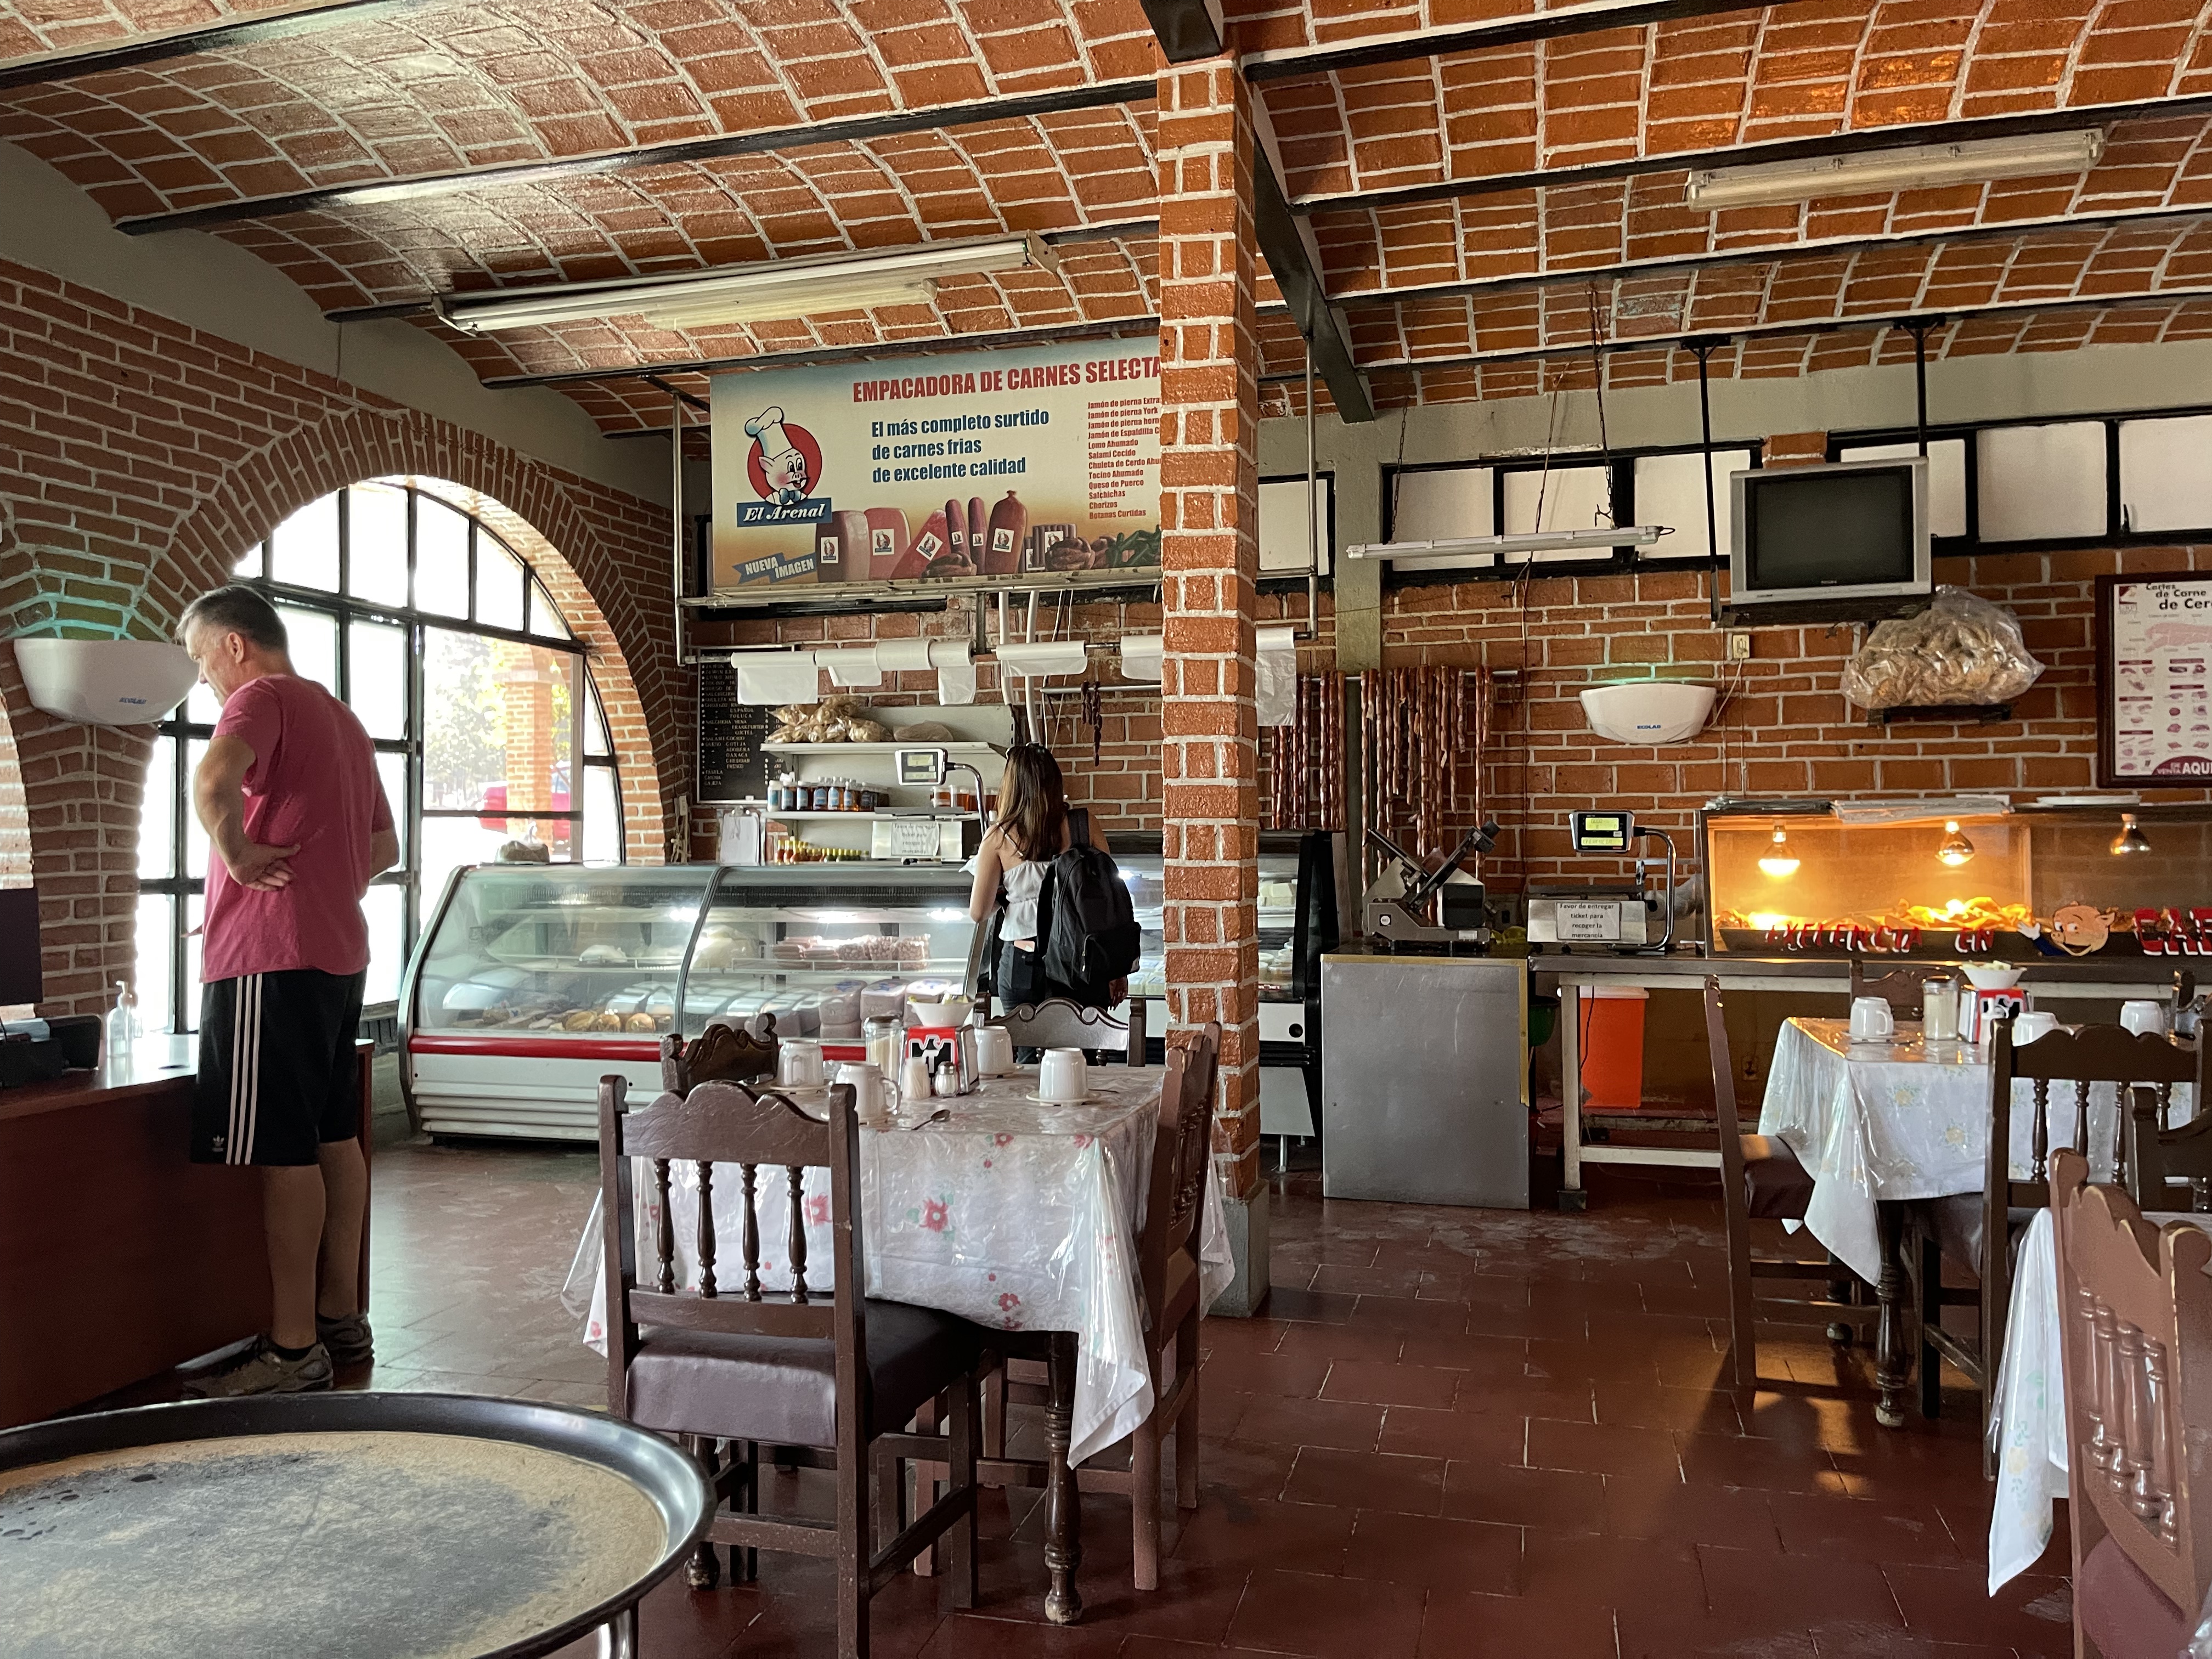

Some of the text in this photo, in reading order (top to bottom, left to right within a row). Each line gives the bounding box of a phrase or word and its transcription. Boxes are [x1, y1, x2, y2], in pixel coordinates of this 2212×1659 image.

[853, 357, 1160, 403] EMPACADORA DE CARNES SELECTA
[1088, 400, 1109, 409] Jamón
[1120, 399, 1142, 407] pierna
[1088, 410, 1109, 419] Jamón
[872, 409, 1049, 437] El más completo surtido
[1088, 421, 1109, 429] Jamón
[1120, 419, 1142, 427] pierna
[1088, 431, 1109, 439] Jamón
[1120, 427, 1153, 437] Espaldilla
[872, 438, 981, 460] de carnes frias
[1107, 439, 1138, 448] Ahumado
[1113, 449, 1136, 458] Cocido
[872, 457, 1026, 483] de excelente calidad
[1112, 469, 1143, 478] Ahumado
[1089, 489, 1126, 499] Salchichas
[1089, 501, 1118, 509] Chorizos
[743, 504, 825, 522] El Arenal
[1089, 511, 1116, 520] Botanas
[745, 556, 778, 575] NUEVA
[774, 558, 814, 579] IMAGEN
[2159, 598, 2212, 610] de Cer
